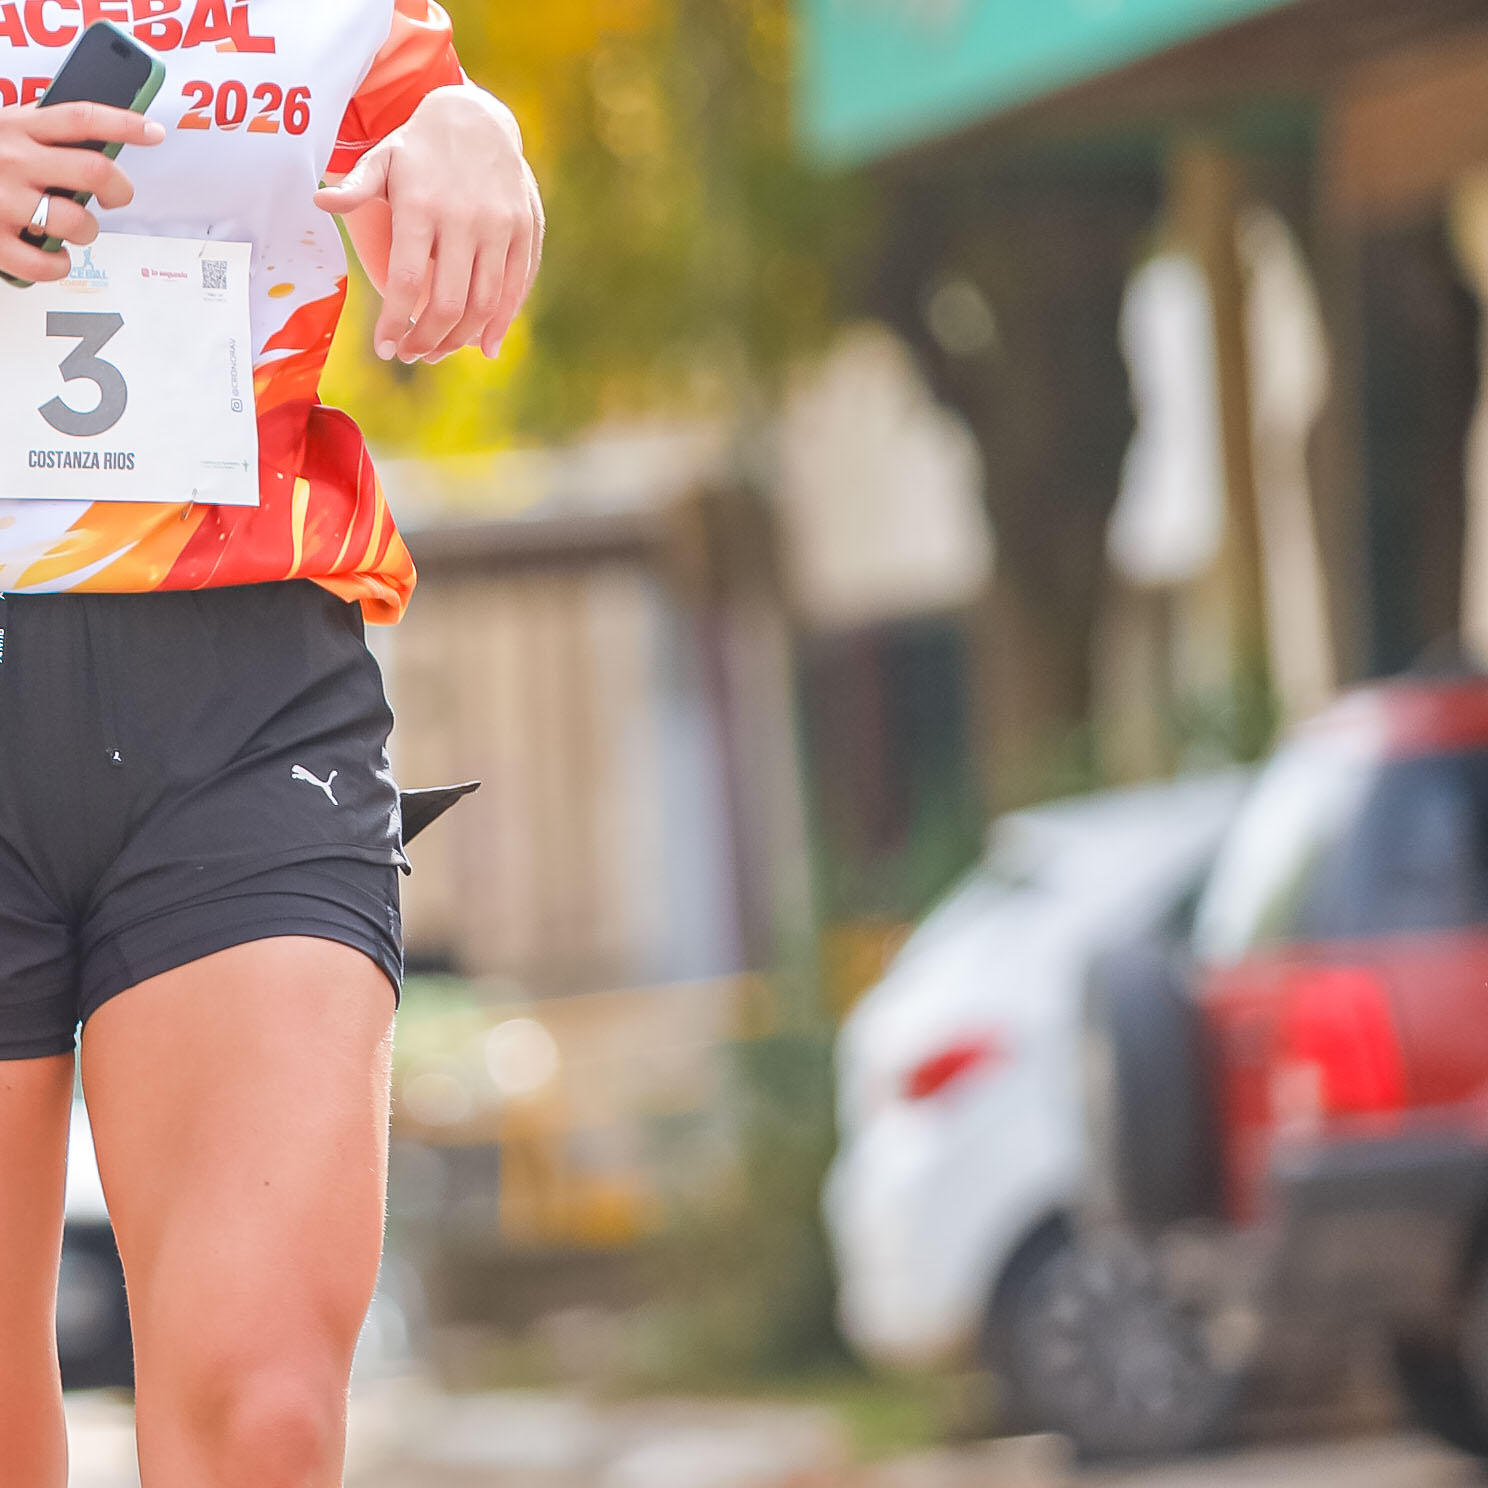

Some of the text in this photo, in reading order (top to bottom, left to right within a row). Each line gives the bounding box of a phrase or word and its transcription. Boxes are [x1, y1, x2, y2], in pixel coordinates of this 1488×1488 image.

[176, 80, 311, 135] 2026
[37, 310, 128, 437] 3
[28, 450, 136, 471] COSTANZA RIOS
